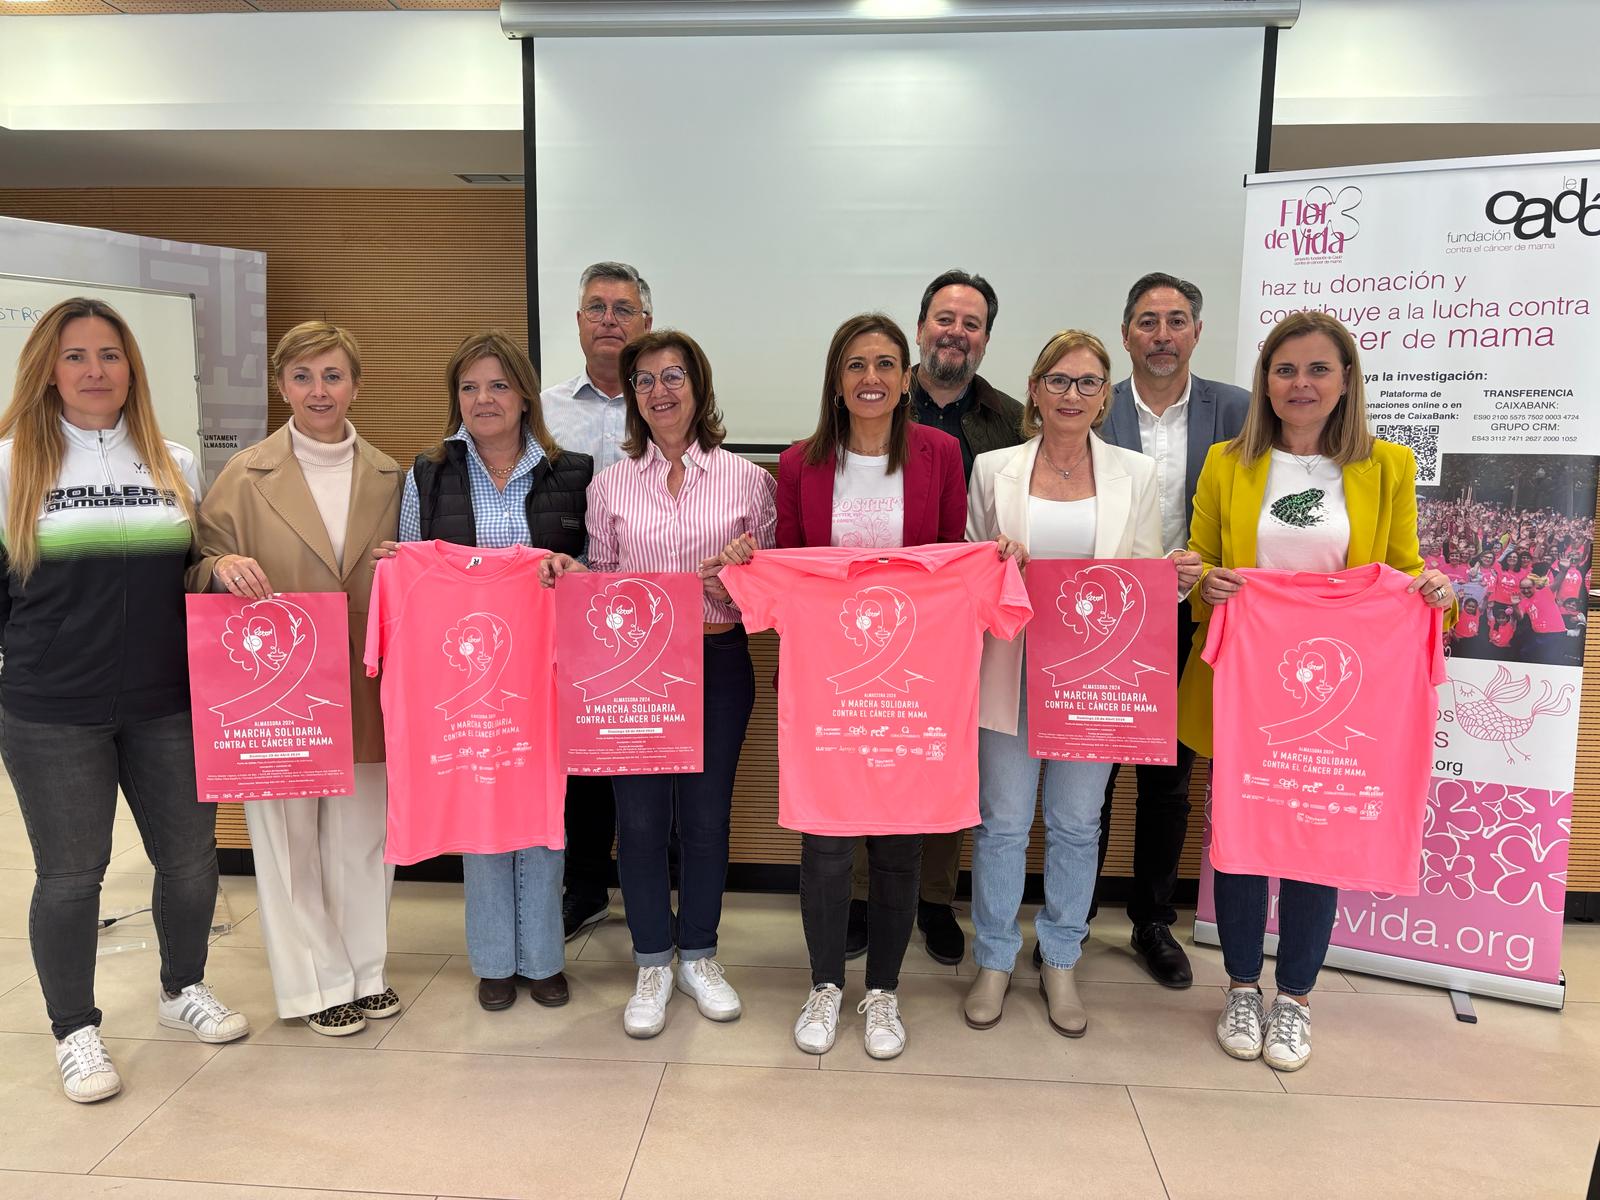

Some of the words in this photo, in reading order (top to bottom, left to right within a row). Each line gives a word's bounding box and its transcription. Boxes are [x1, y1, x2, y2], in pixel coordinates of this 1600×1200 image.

[1562, 175, 1577, 190] le
[1280, 199, 1333, 227] Flor
[1264, 229, 1289, 250] de
[1291, 226, 1345, 256] Vida
[1447, 229, 1511, 243] fundación
[1445, 245, 1472, 254] contra
[1473, 244, 1482, 252] el
[1514, 243, 1526, 251] de
[1528, 242, 1555, 250] mama
[1261, 280, 1297, 296] haz
[1303, 279, 1321, 295] tu
[1330, 271, 1445, 293] donación
[1454, 275, 1467, 293] y
[1388, 307, 1400, 320] a
[1407, 302, 1424, 319] la
[1432, 298, 1500, 319] lucha
[1508, 296, 1590, 317] contra
[1402, 329, 1436, 349] de
[1448, 325, 1555, 349] mama
[1382, 372, 1393, 381] la
[1397, 370, 1488, 383] investigación:
[1380, 390, 1428, 398] Plataforma
[1430, 390, 1442, 398] de
[1483, 389, 1574, 397] TRANSFERENCIA
[1412, 401, 1439, 409] online
[1495, 401, 1559, 410] CAIXABANK:
[1394, 412, 1405, 420] de
[1408, 412, 1459, 420] CaixaBank:
[1490, 423, 1530, 431] GRUPO
[1532, 423, 1560, 431] CRM:
[1054, 690, 1060, 699] V
[1063, 690, 1098, 700] MARCHA
[1101, 691, 1148, 702] SOLIDARIA
[585, 705, 591, 714] V
[594, 704, 629, 713] MARCHA
[631, 703, 676, 713] SOLIDARIA
[880, 700, 920, 709] SOLIDARIA
[1045, 700, 1074, 709] CONTRA
[1076, 702, 1086, 710] EL
[1088, 701, 1119, 711] CÁNCER
[1121, 703, 1131, 711] DE
[1134, 704, 1158, 713] MAMA
[576, 715, 606, 724] CONTRA
[608, 715, 617, 723] EL
[619, 713, 648, 723] CÁNCER
[663, 714, 686, 722] MAMA
[832, 709, 857, 717] CONTRA
[869, 709, 895, 718] CÁNCER
[897, 710, 906, 718] DE
[908, 711, 928, 719] MAMA
[224, 729, 230, 739] V
[233, 727, 272, 738] MARCHA
[274, 726, 323, 737] SOLIDARIA
[502, 726, 520, 735] MAMA
[213, 740, 246, 750] CONTRA
[249, 739, 259, 748] EL
[261, 737, 293, 748] CÁNCER
[296, 738, 306, 746] DE
[309, 737, 333, 746] MAMA
[1273, 750, 1278, 759] V
[1280, 751, 1313, 763] MARCHA
[1316, 756, 1358, 766] SOLIDARIA
[1262, 759, 1289, 770] CONTRA
[1292, 763, 1300, 771] EL
[1303, 764, 1331, 775] CÁNCER
[1333, 767, 1342, 775] DE
[1344, 768, 1366, 776] MAMA
[1431, 760, 1463, 776] .org
